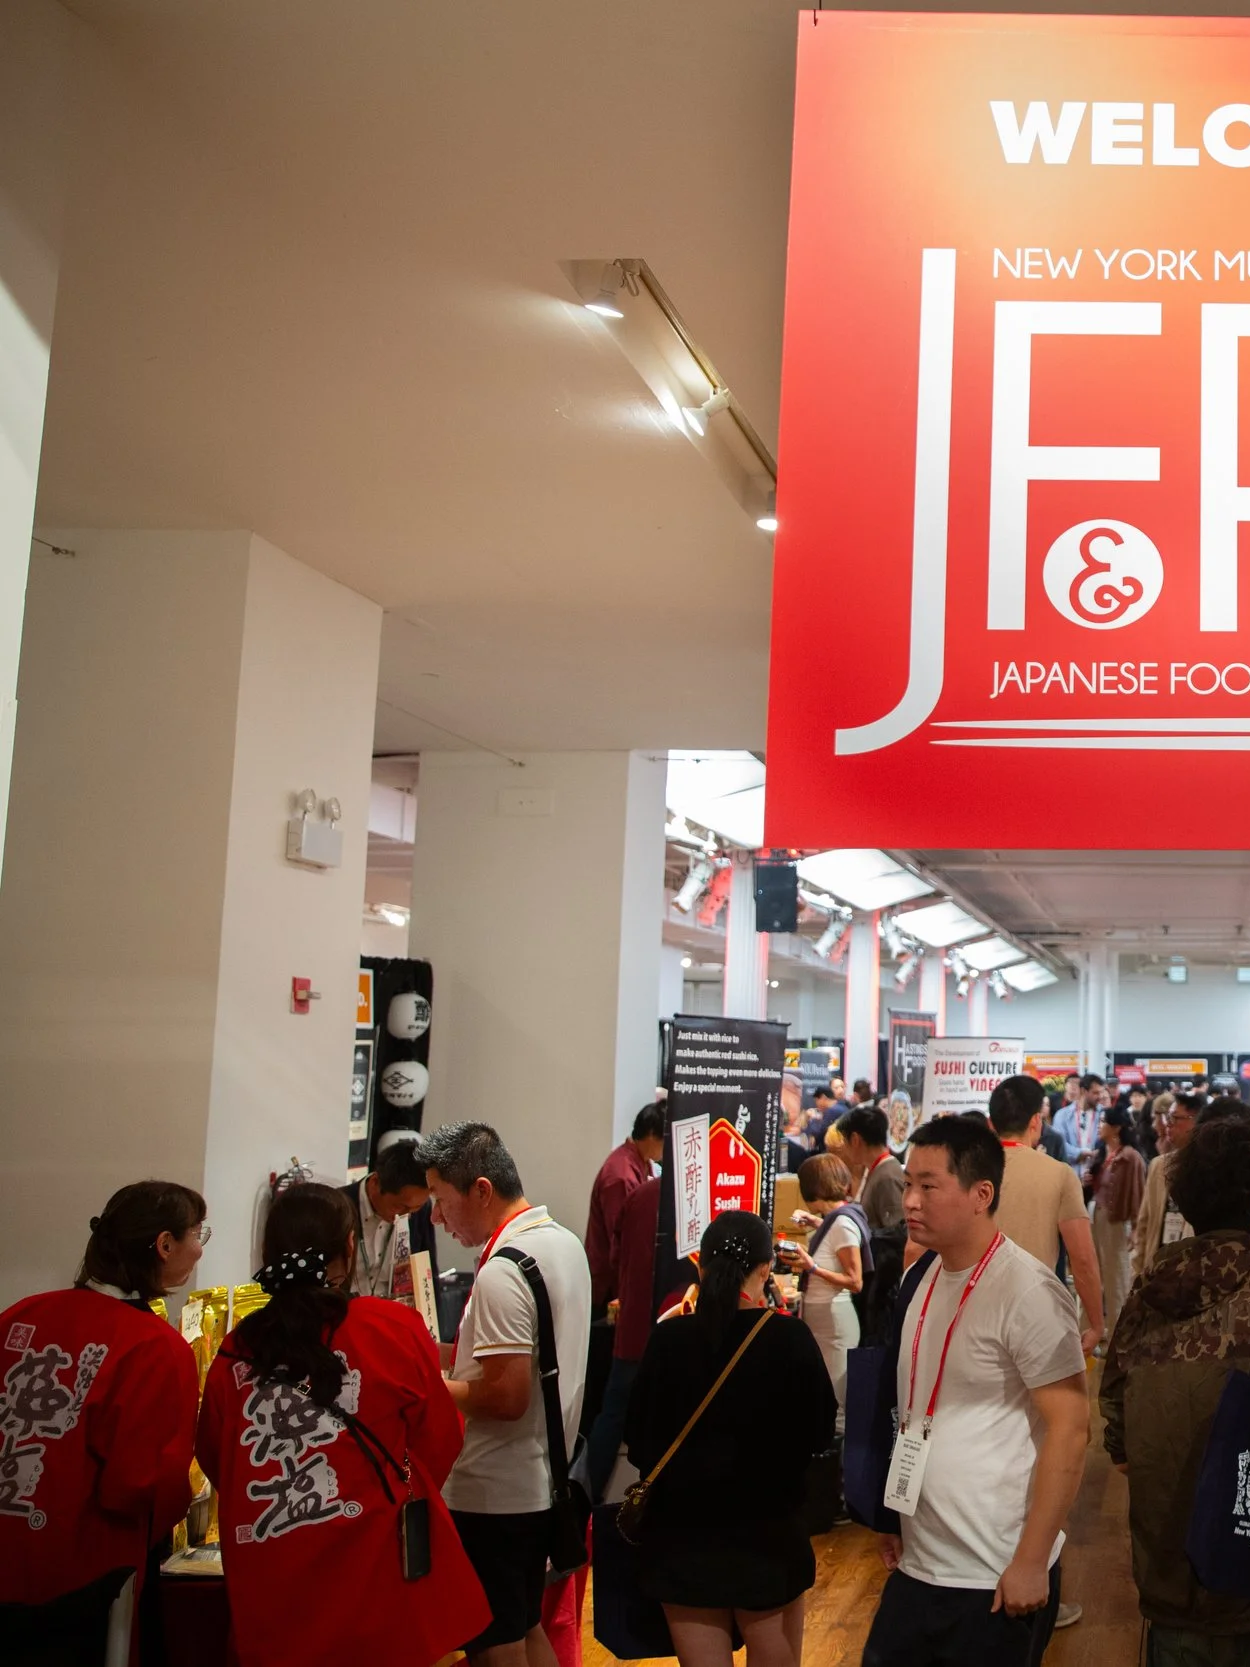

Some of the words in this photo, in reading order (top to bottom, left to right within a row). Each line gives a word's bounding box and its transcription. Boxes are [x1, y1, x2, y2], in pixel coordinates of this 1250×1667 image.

[993, 247, 1082, 279] NEW
[1095, 249, 1202, 281] YORK
[990, 662, 1158, 698] JAPANESE
[677, 1030, 691, 1041] Just
[692, 1032, 702, 1041] mix
[709, 1033, 721, 1043] with
[721, 1034, 732, 1043] rice
[732, 1035, 740, 1044] to
[675, 1048, 695, 1058] make
[695, 1049, 721, 1060] authentic
[721, 1050, 732, 1060] red
[732, 1051, 747, 1061] sushi
[674, 1064, 696, 1075] Makes
[696, 1065, 707, 1075] the
[707, 1066, 728, 1079] topping
[728, 1068, 743, 1077] even
[743, 1069, 758, 1078] more
[934, 1060, 966, 1075] SUSHI
[969, 1060, 1018, 1075] CULTURE
[673, 1081, 693, 1094] Enjoy
[698, 1083, 717, 1094] special
[716, 1172, 745, 1187] Akazu
[714, 1196, 741, 1211] Sushi
[1234, 1526, 1246, 1535] New
